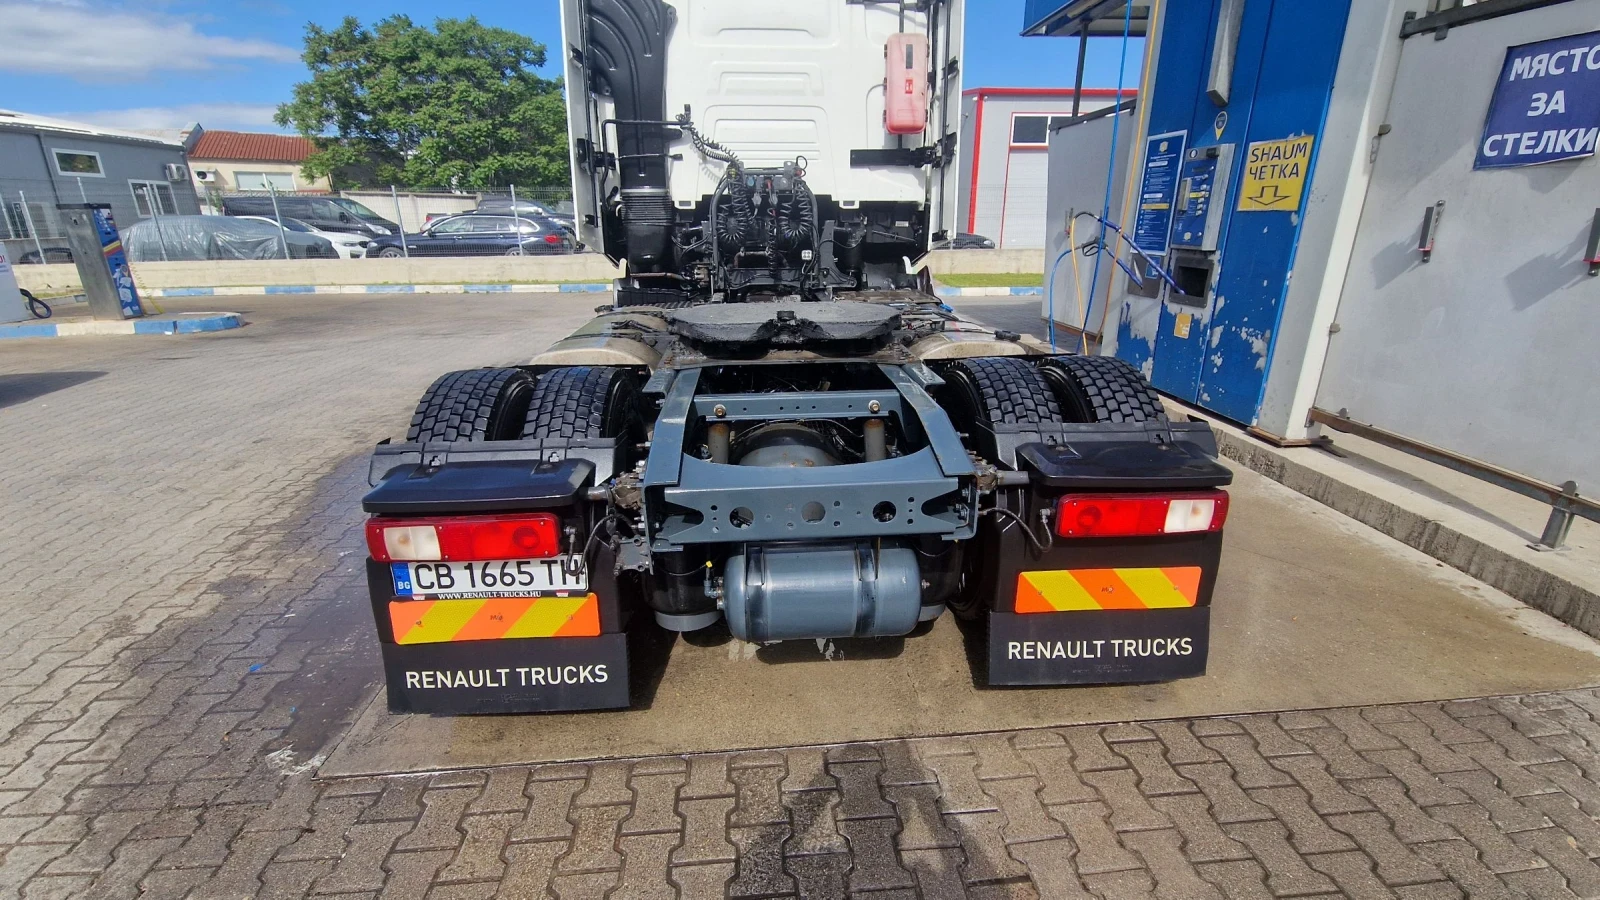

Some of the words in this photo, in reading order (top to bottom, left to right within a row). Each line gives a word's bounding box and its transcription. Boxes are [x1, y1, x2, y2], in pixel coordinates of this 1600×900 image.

[1509, 45, 1600, 81] МЯСТО
[1527, 90, 1565, 117] ЗА
[1250, 142, 1308, 163] SHAUM
[1483, 127, 1599, 157] СТЕЛКИ
[1249, 162, 1300, 180] ЧЕТКА
[397, 581, 411, 590] BG
[414, 563, 455, 590] CB
[463, 561, 535, 588] 1665
[438, 591, 542, 599] WWW.RENAULT-TRUCKS.HU
[1008, 640, 1105, 660] RENAULT
[1110, 637, 1193, 658] TRUCKS
[405, 668, 510, 689] RENAULT
[516, 664, 608, 686] TRUCKS
